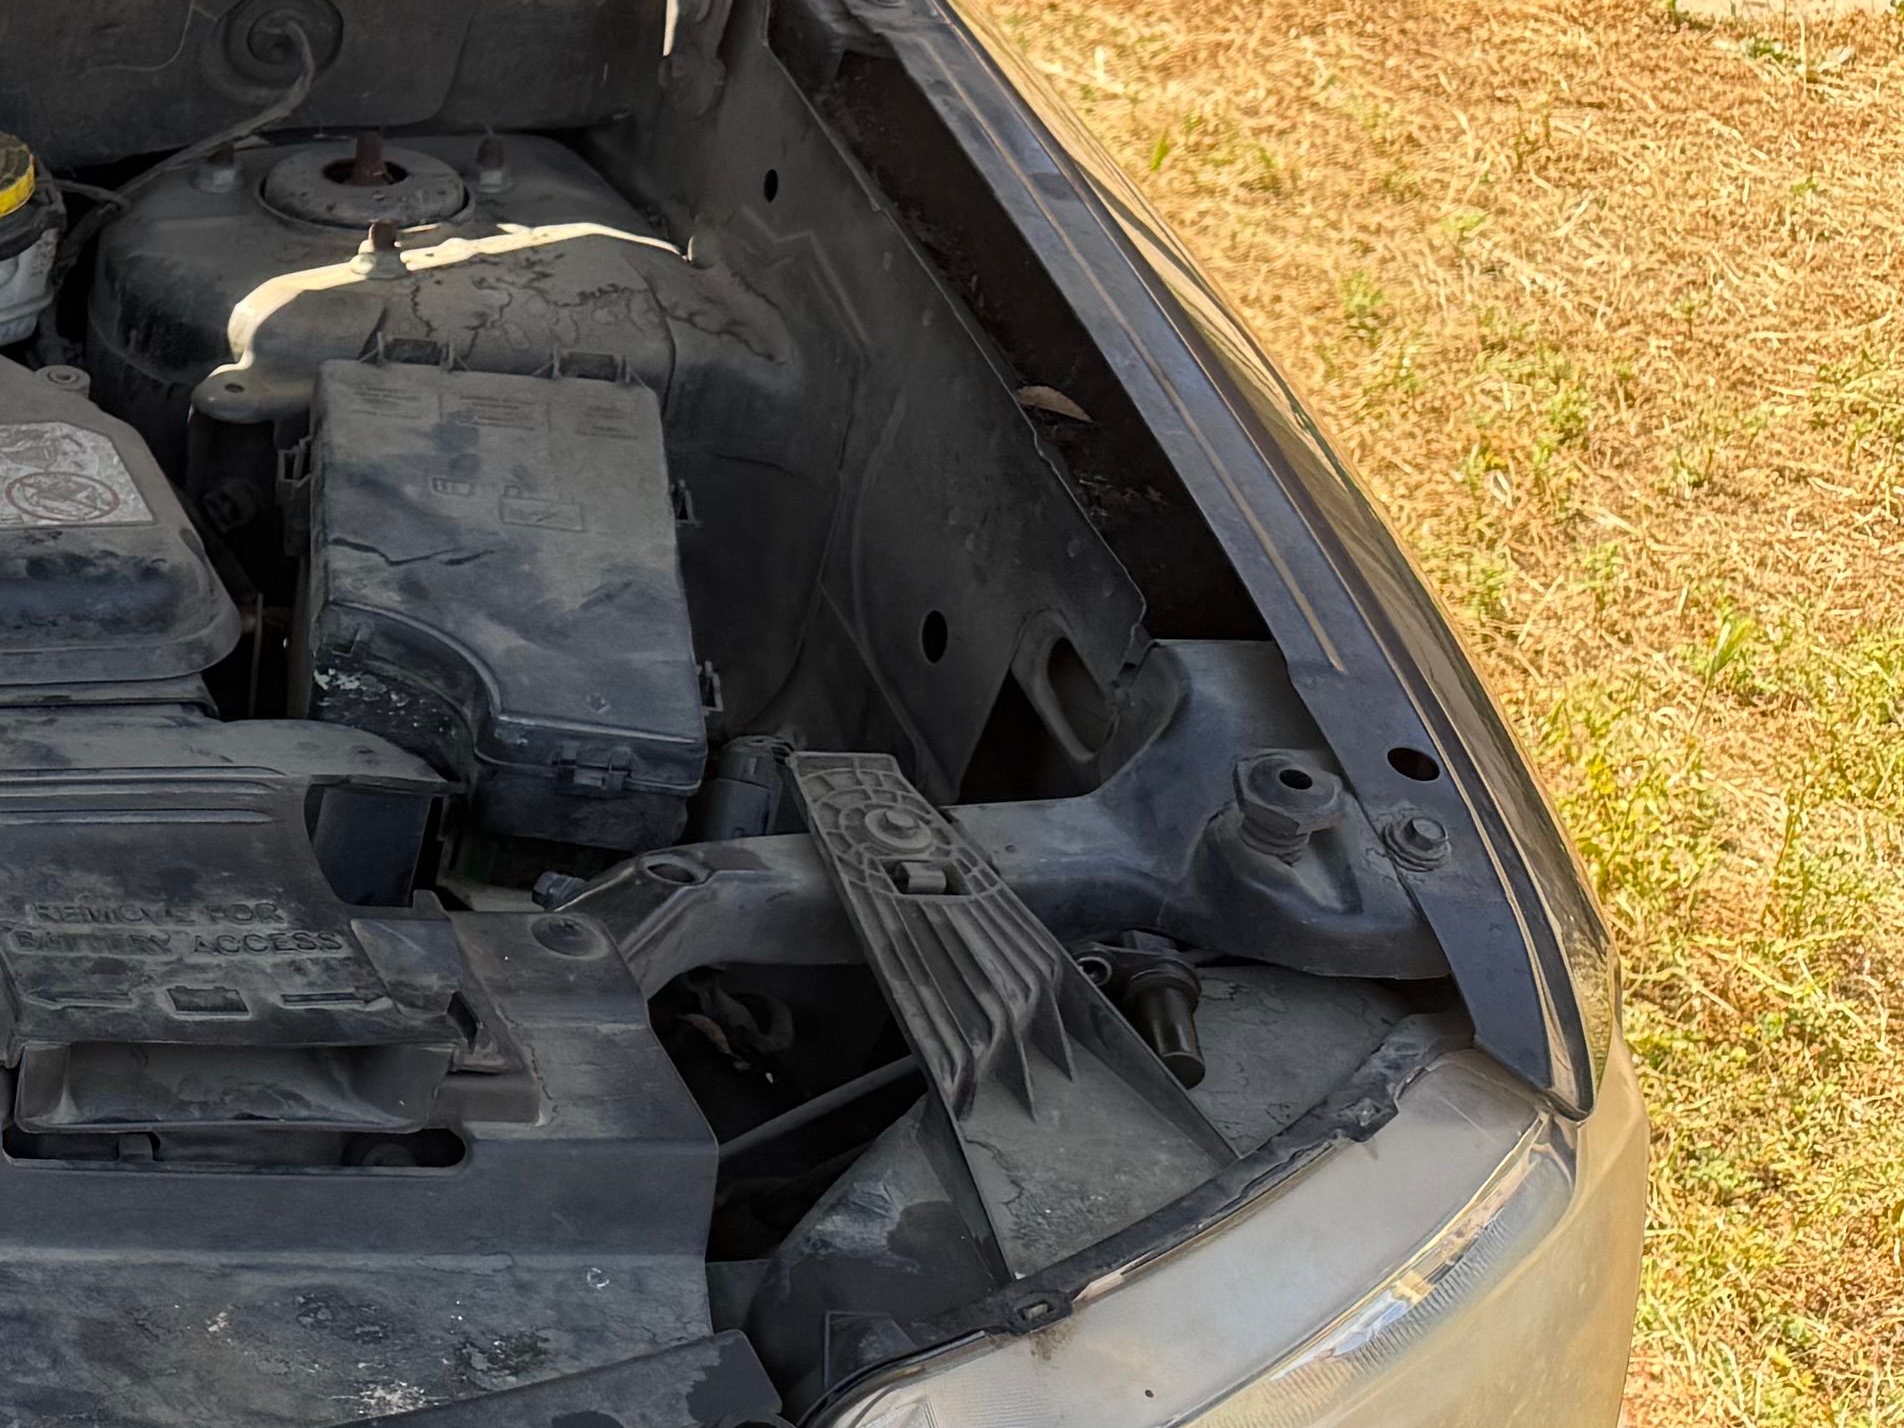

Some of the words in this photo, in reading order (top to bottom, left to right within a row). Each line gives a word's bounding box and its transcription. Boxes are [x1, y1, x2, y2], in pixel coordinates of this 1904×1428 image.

[31, 902, 194, 925] REMOVE
[204, 902, 286, 925] FOR
[193, 931, 344, 954] ACCESS
